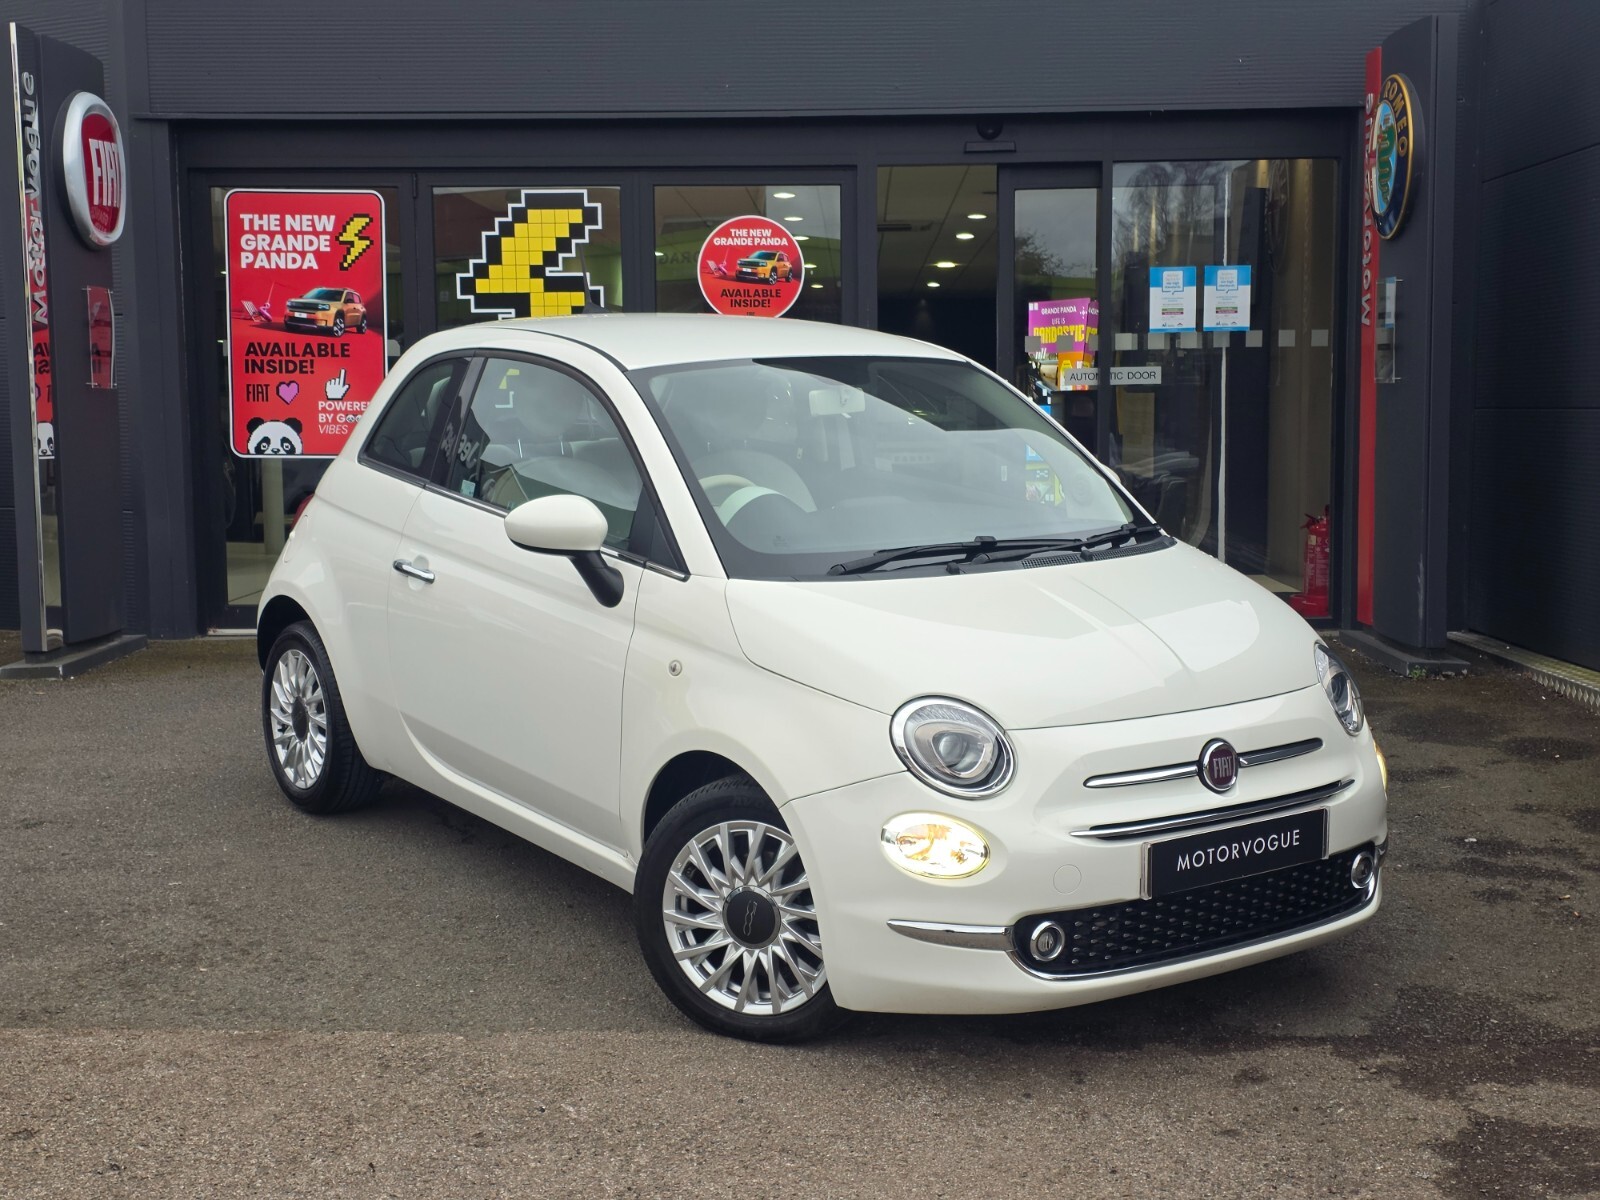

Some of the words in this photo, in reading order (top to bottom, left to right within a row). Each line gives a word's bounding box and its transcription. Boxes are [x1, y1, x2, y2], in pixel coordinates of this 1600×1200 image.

[1383, 81, 1408, 157] ROMEO
[88, 138, 121, 208] FIAT
[22, 71, 49, 325] Motorvogue
[240, 213, 281, 231] THE
[285, 214, 336, 232] NEW
[713, 237, 753, 246] GRANDE
[754, 237, 789, 246] PANDA
[730, 229, 748, 237] THE
[750, 229, 772, 237] NEW
[240, 234, 331, 252] GRANDE
[240, 252, 319, 270] PANDA
[720, 288, 782, 298] AVAILABLE
[730, 299, 771, 308] INSIDE!
[1041, 307, 1059, 315] GRANDE
[1060, 305, 1077, 313] PANDA
[244, 342, 350, 358] AVAILABLE
[244, 358, 315, 375] INSIDE!
[1069, 371, 1124, 381] AUTOTIC
[1127, 371, 1157, 380] DOOR
[246, 383, 270, 403] FIAT
[318, 413, 334, 423] BY
[318, 424, 349, 435] VIBES
[1212, 755, 1233, 779] FIAT
[1176, 829, 1300, 872] MOTORVOGUE
